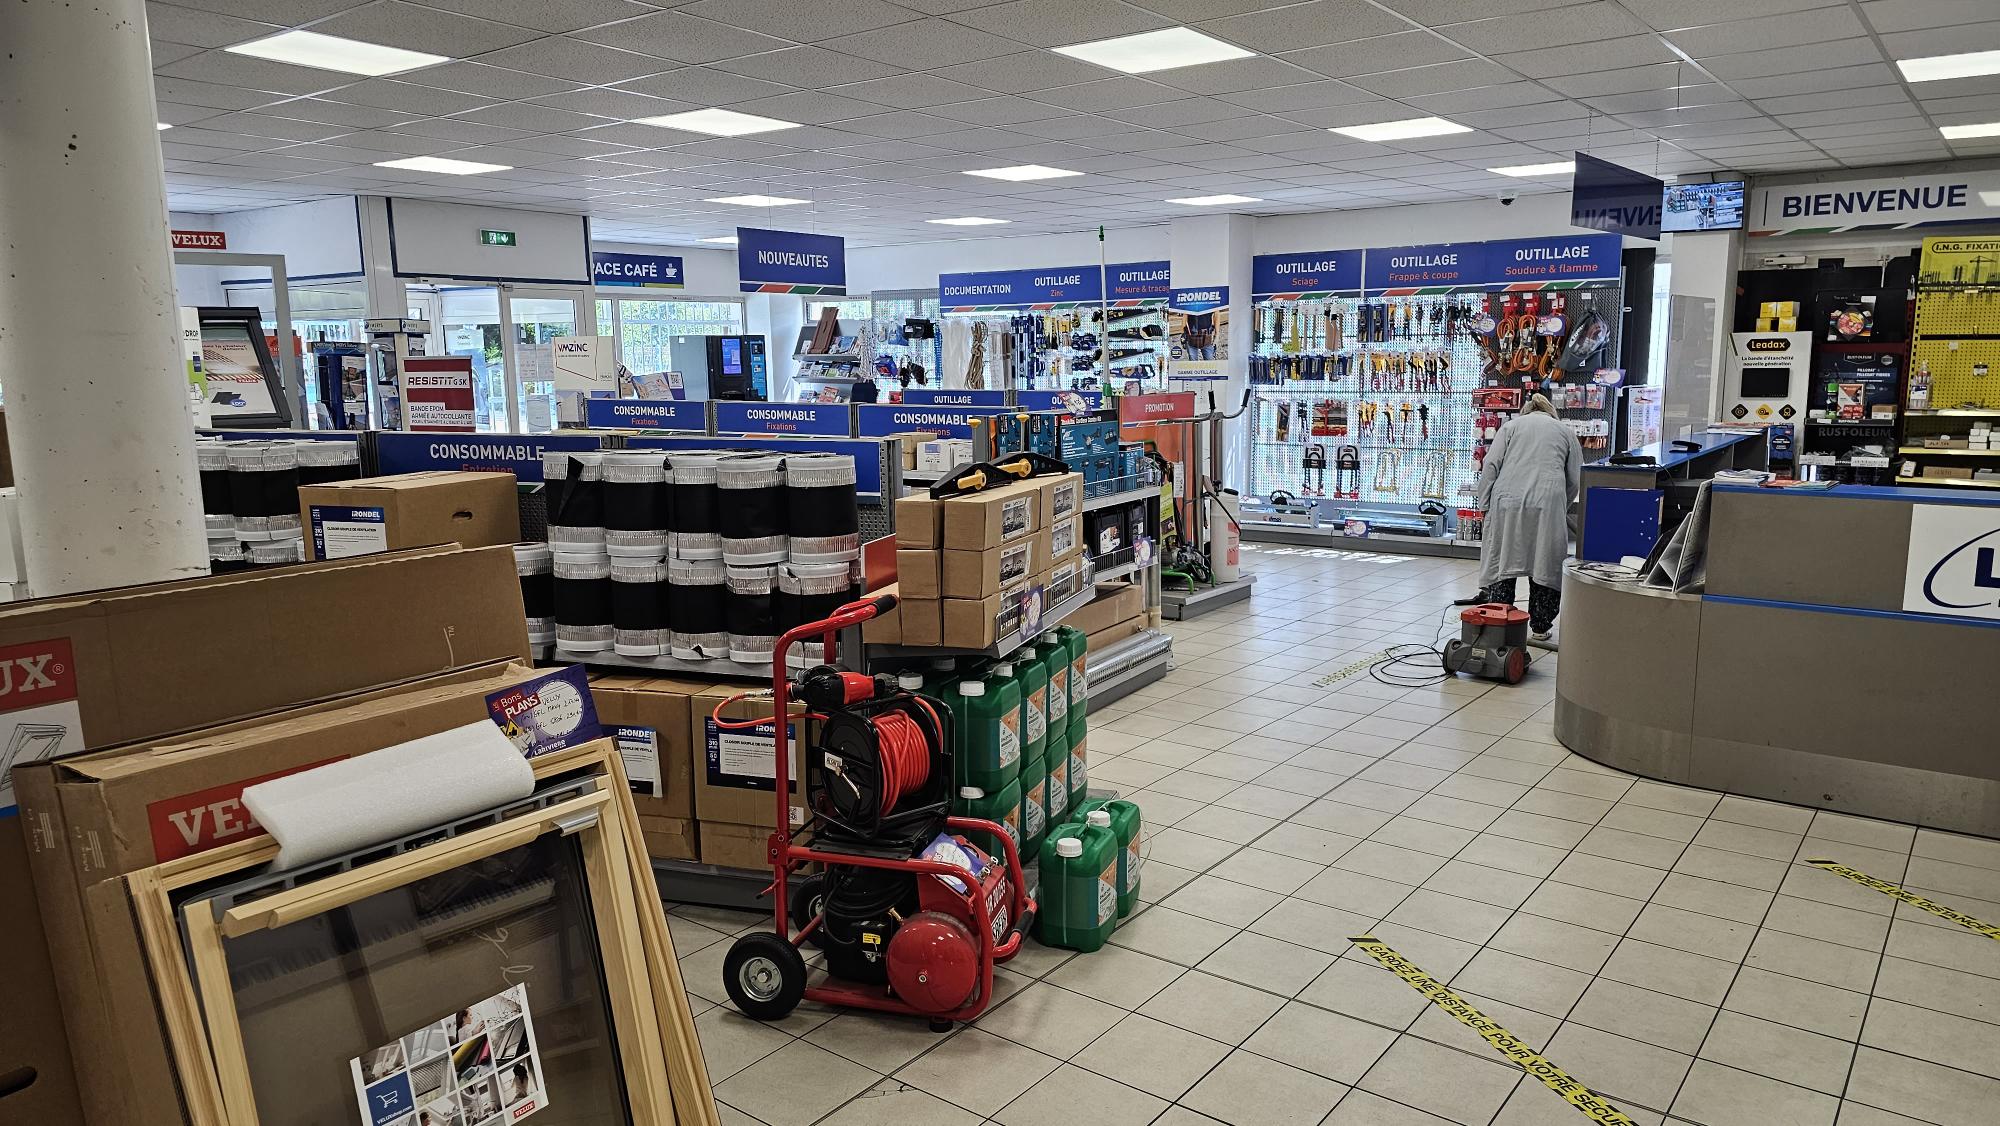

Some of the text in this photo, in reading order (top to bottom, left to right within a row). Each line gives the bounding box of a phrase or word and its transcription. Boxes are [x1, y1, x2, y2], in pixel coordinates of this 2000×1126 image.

[1782, 184, 1967, 217] BIENVENUE
[171, 234, 222, 247] VELUX
[1936, 243, 1963, 251] I.N.G.
[758, 250, 829, 268] NOUVEAUTES
[1516, 246, 1590, 261] OUTILLAGE
[1391, 254, 1458, 268] OUTILLAGE
[624, 262, 657, 277] CAFÉ
[1276, 261, 1336, 274] OUTILLAGE
[1505, 263, 1598, 275] Soudure & flamme
[1034, 275, 1080, 287] OUTILLAGE
[1119, 270, 1169, 283] OUTILLAGE
[1292, 277, 1318, 287] Sciage
[1389, 271, 1458, 283] Frappe & coupe
[944, 284, 1011, 296] DOCUMENTATION
[1050, 289, 1064, 297] Zinc
[1115, 286, 1140, 294] Mesure
[1141, 285, 1147, 293] &
[558, 343, 588, 352] VMZINC
[1751, 340, 1786, 349] Leadax
[934, 395, 971, 404] OUTILLAGE
[614, 405, 675, 417] CONSOMMABLE
[1145, 403, 1174, 413] PROMOTION
[747, 409, 816, 421] CONSOMMABLE
[894, 413, 973, 426] CONSOMMABLE
[631, 418, 658, 426] Fixations
[766, 422, 796, 431] Fixations
[1818, 428, 1890, 437] RUST-OLEUM
[430, 443, 545, 461] CONSOMMABLE
[501, 692, 521, 707] Bons
[505, 694, 538, 719] PLANS
[618, 728, 651, 738] IRONDE
[755, 725, 776, 733] IRON
[169, 798, 261, 846] VE
[1918, 900, 1992, 932] DISTANCE
[1370, 945, 1415, 975] GARDEZ
[1411, 975, 1437, 992] UNE
[1434, 991, 1493, 1032] DISTANCE
[1490, 1032, 1530, 1059] POUR
[1529, 1059, 1579, 1092] VOTRE
[514, 1102, 534, 1117] VELUX
